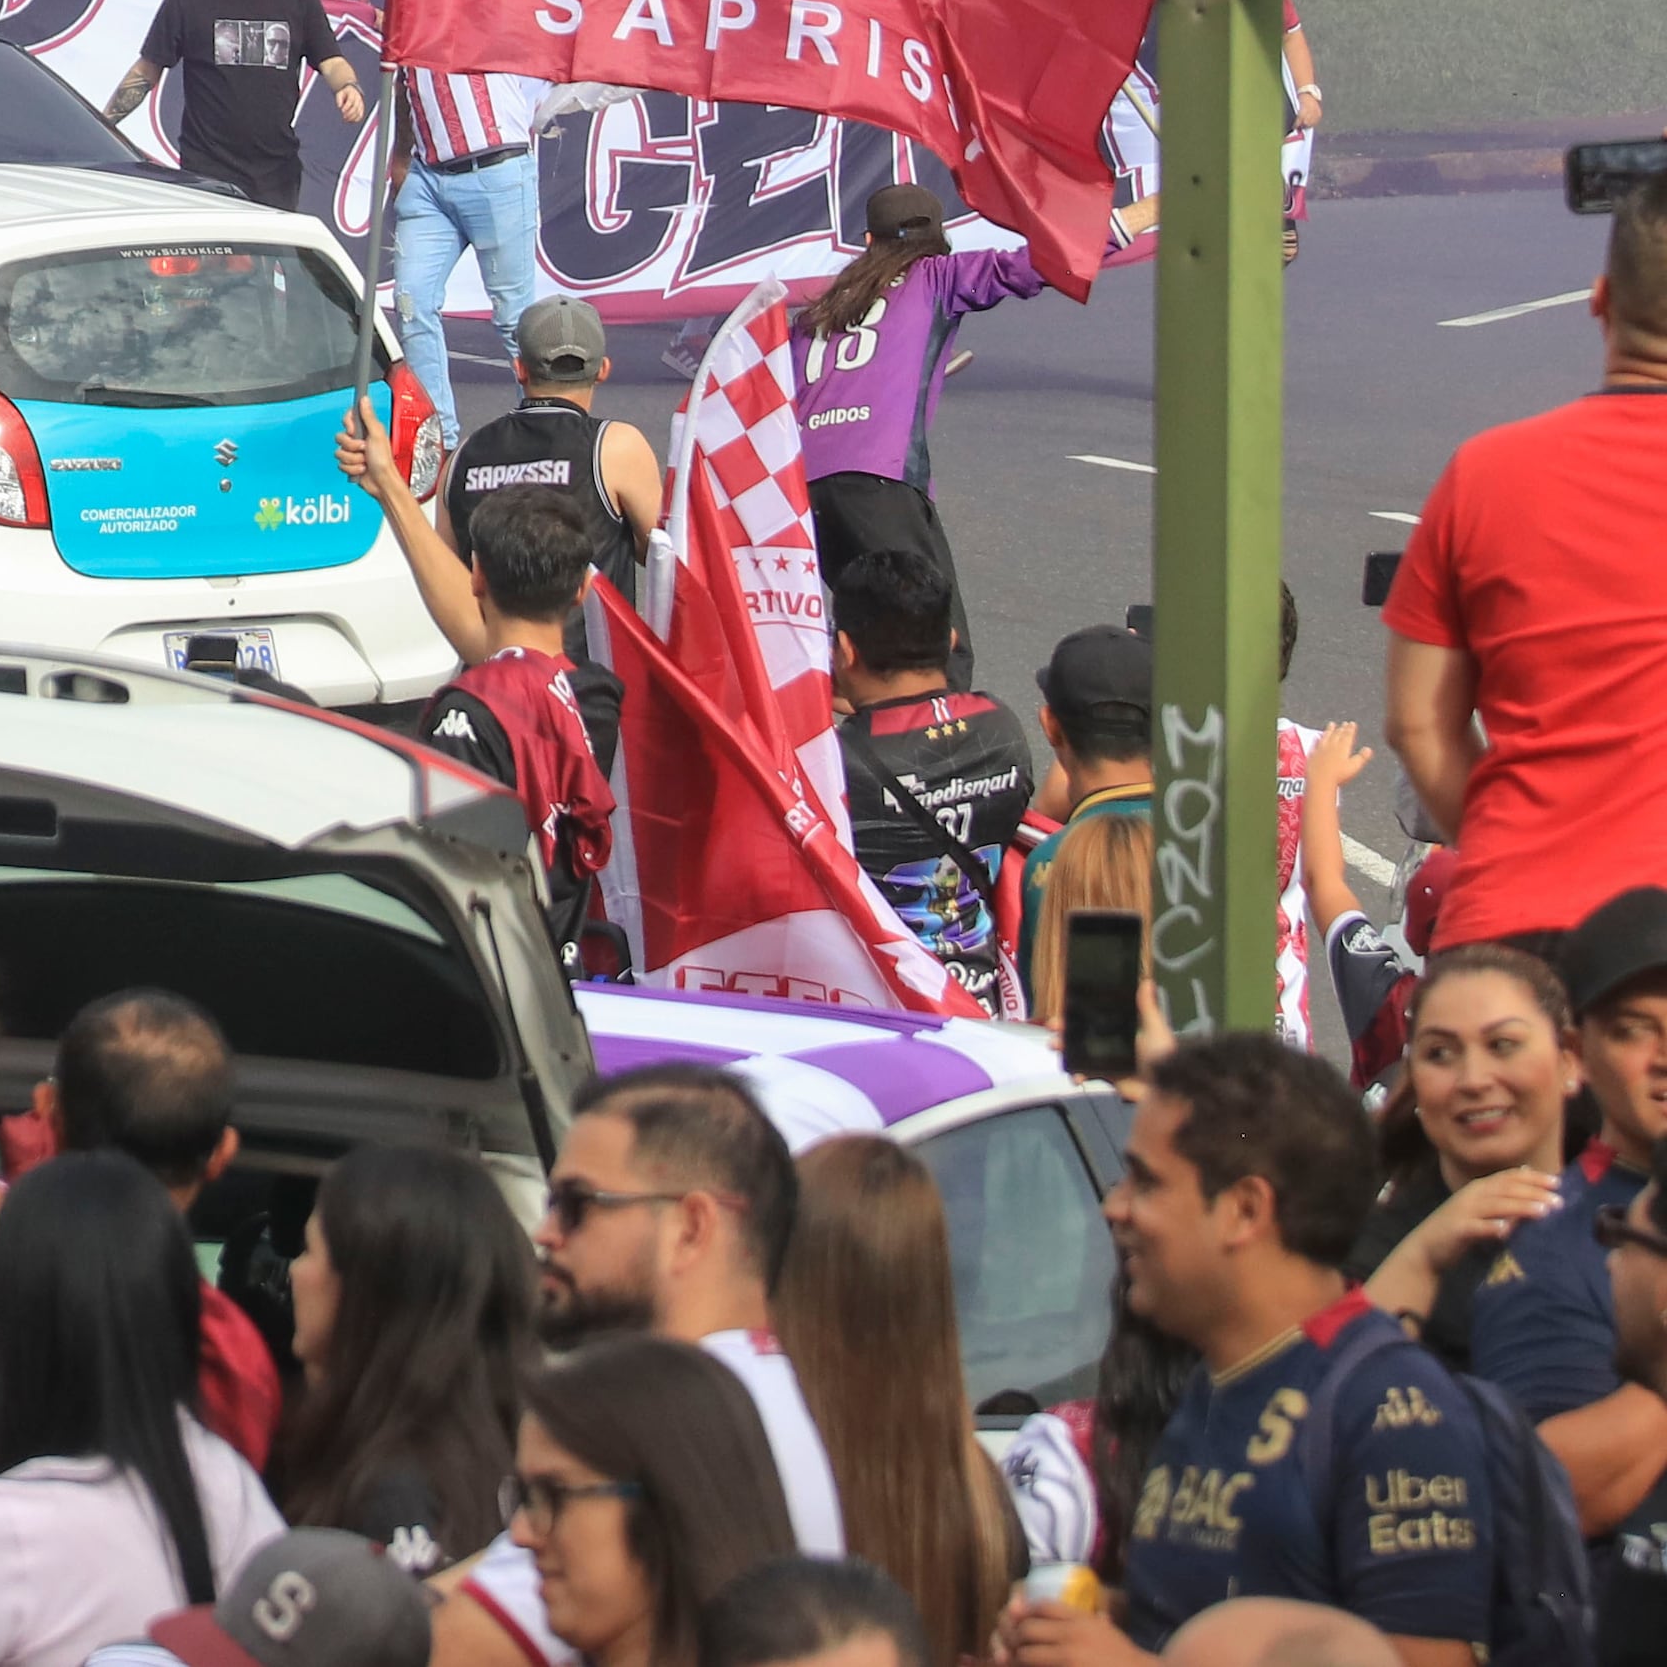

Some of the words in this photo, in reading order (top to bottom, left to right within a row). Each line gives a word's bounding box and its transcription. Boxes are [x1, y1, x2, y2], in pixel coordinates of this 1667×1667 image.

[119, 245, 234, 259] WWW.SUZUKI.CR
[465, 459, 570, 492] SAPRISSA
[80, 505, 196, 521] COMERCIALIZADOR
[99, 519, 178, 534] AUTORIZADO
[286, 494, 350, 525] kölbi
[914, 764, 1018, 810] medismart
[1247, 1388, 1309, 1466] S
[1367, 1468, 1466, 1513] Uber
[1368, 1511, 1474, 1555] Eats
[252, 1571, 318, 1642] S
